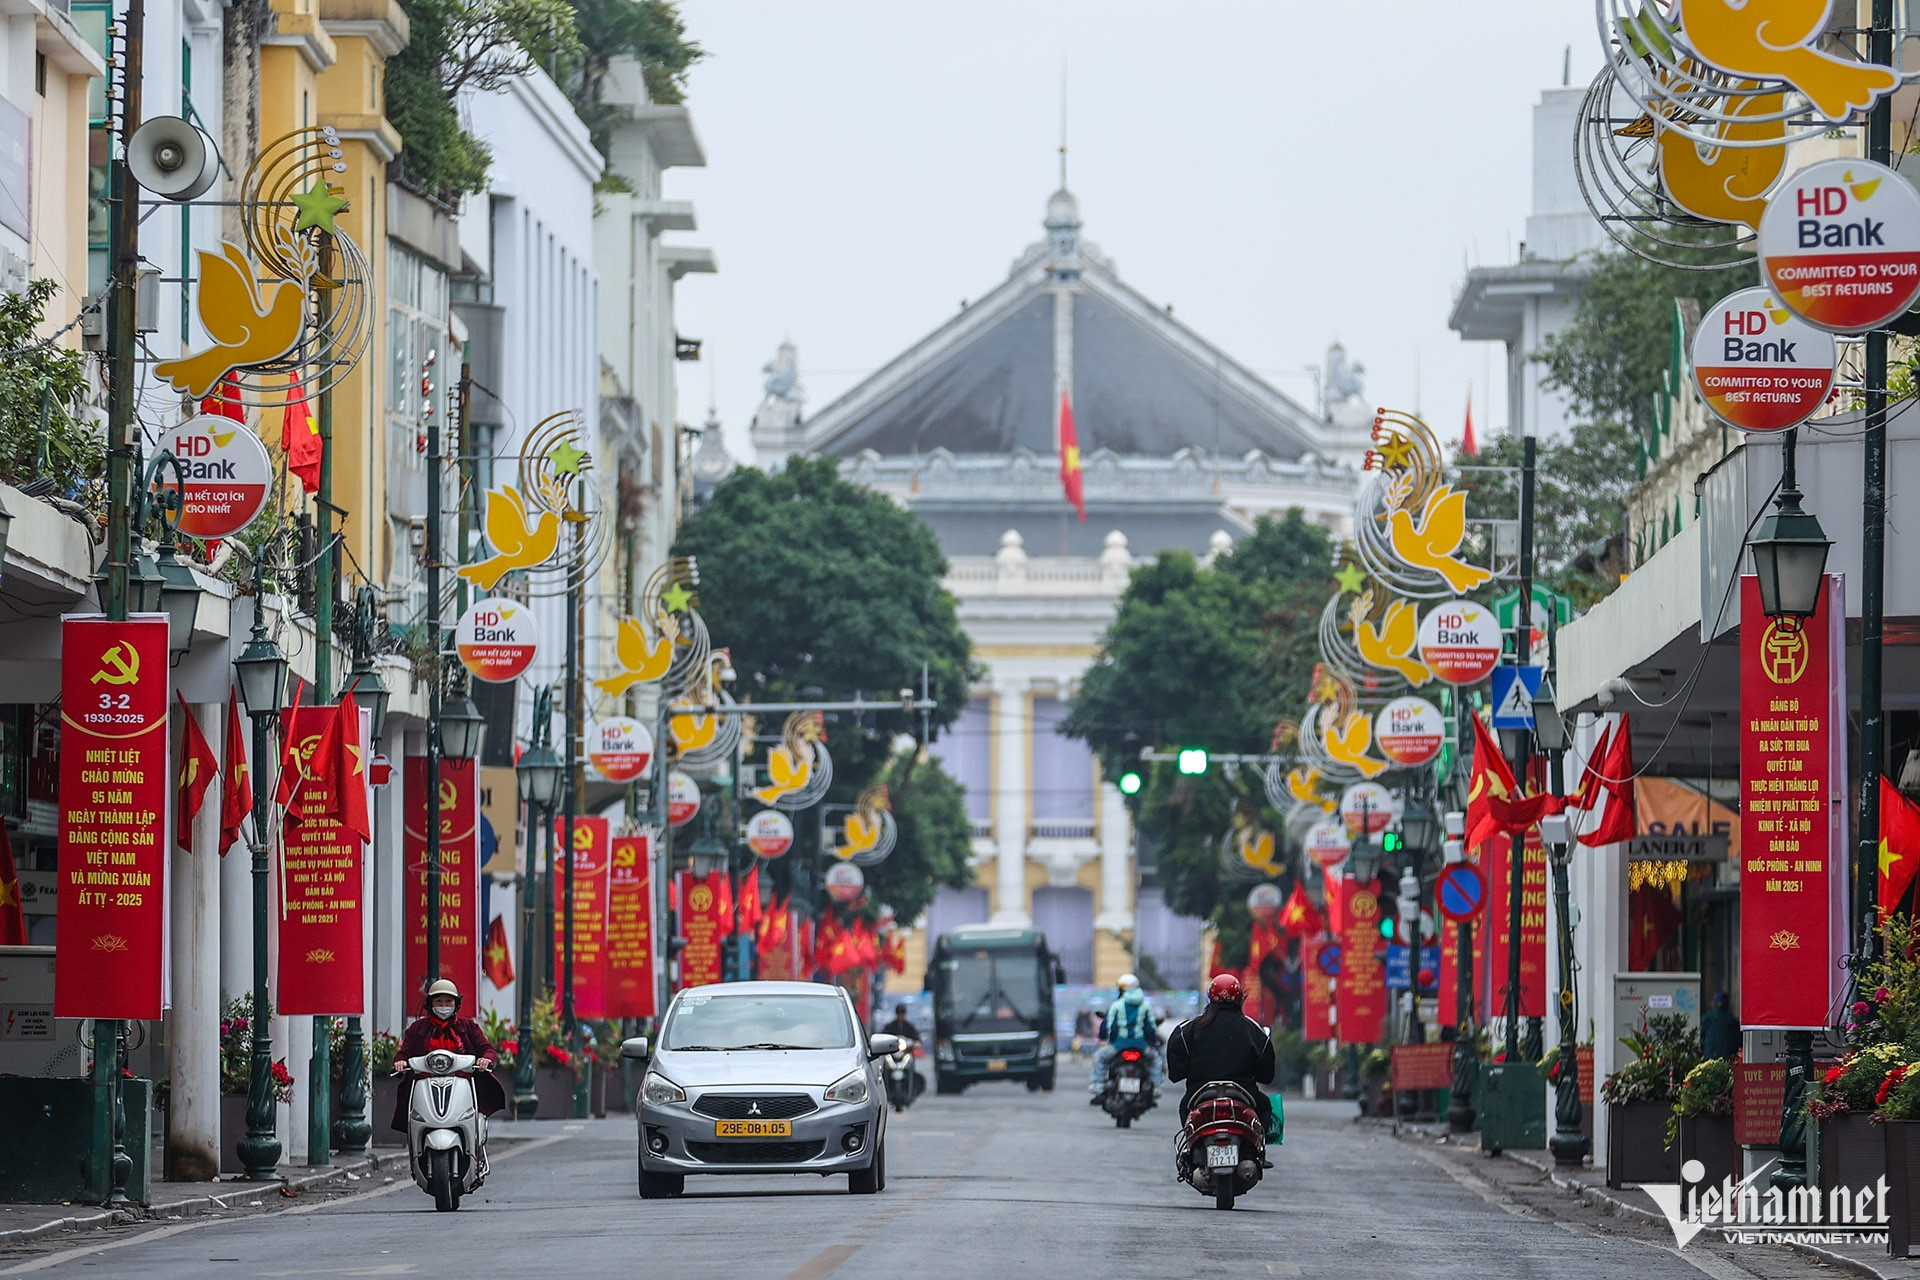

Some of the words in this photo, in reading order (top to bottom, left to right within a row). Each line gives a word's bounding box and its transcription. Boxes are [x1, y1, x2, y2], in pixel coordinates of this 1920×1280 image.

[1797, 187, 1847, 217] HD
[1799, 218, 1885, 248] Bank
[1777, 266, 1857, 281] COMMITTED
[1859, 265, 1878, 277] TO
[1880, 263, 1917, 277] YOUR
[1802, 284, 1834, 298] BEST
[1835, 282, 1893, 297] RETURNS
[1724, 311, 1767, 335] HD
[1724, 337, 1797, 363] Bank
[1705, 376, 1771, 388] COMMITTED
[1773, 377, 1789, 388] TO
[1791, 378, 1823, 389] YOUR
[1725, 392, 1751, 403] BEST
[1753, 392, 1802, 403] RETURNS
[176, 436, 211, 457] HD
[178, 459, 236, 480] Bank
[195, 489, 211, 501] KẾT
[213, 492, 228, 502] LỢI
[230, 491, 245, 501] ÍCH
[186, 505, 206, 514] CAO
[208, 502, 232, 514] NHẤT
[474, 612, 499, 627] HD
[1438, 615, 1462, 629] HD
[474, 627, 516, 643] Bank
[1438, 630, 1479, 645] Bank
[99, 693, 131, 709] 3-2
[1770, 696, 1788, 711] ĐẢNG
[1789, 698, 1799, 714] BỘ
[84, 713, 144, 723] 1930-2025
[1391, 709, 1411, 720] HD
[1391, 721, 1425, 732] Bank
[1750, 718, 1759, 732] VÀ
[1760, 718, 1779, 731] NHÂN
[1780, 717, 1794, 731] DÂN
[602, 728, 622, 739] HD
[602, 740, 634, 751] Bank
[1759, 740, 1769, 752] RA
[1769, 737, 1783, 751] SỨC
[1784, 740, 1795, 751] THI
[1796, 740, 1810, 751] ĐUA
[86, 747, 116, 766] NHIỆT
[119, 748, 140, 767] LIỆT
[1766, 756, 1787, 773] QUYẾT
[1788, 758, 1803, 771] TÂM
[82, 768, 109, 783] CHÀO
[112, 768, 144, 784] MỪNG
[1768, 778, 1784, 794] HIỆN
[92, 791, 105, 804] 95
[108, 788, 133, 804] NĂM
[1750, 798, 1771, 814] NHIỆM
[1782, 797, 1799, 811] PHÁT
[68, 808, 96, 824] NGÀY
[99, 808, 133, 824] THÀNH
[136, 809, 156, 828] LẬP
[1758, 820, 1774, 831] KINH
[1775, 816, 1783, 831] TẾ
[1799, 818, 1811, 834] HỘI
[69, 825, 98, 844] ĐẢNG
[101, 828, 130, 847] CỘNG
[132, 827, 154, 845] SẢN
[1785, 835, 1800, 851] BẢO
[86, 849, 109, 868] VIỆT
[111, 852, 136, 865] NAM
[1747, 856, 1765, 872] QUỐC
[1794, 860, 1804, 872] AN
[1805, 860, 1822, 872] NINH
[71, 868, 85, 884] VÀ
[87, 869, 119, 885] MỪNG
[122, 870, 151, 886] XUÂN
[1766, 878, 1781, 892] NĂM
[1782, 880, 1799, 892] 2025
[78, 887, 92, 905] ẤT
[94, 892, 107, 908] TỴ
[116, 893, 143, 906] 2025
[722, 1123, 786, 1134] 29E-081.05
